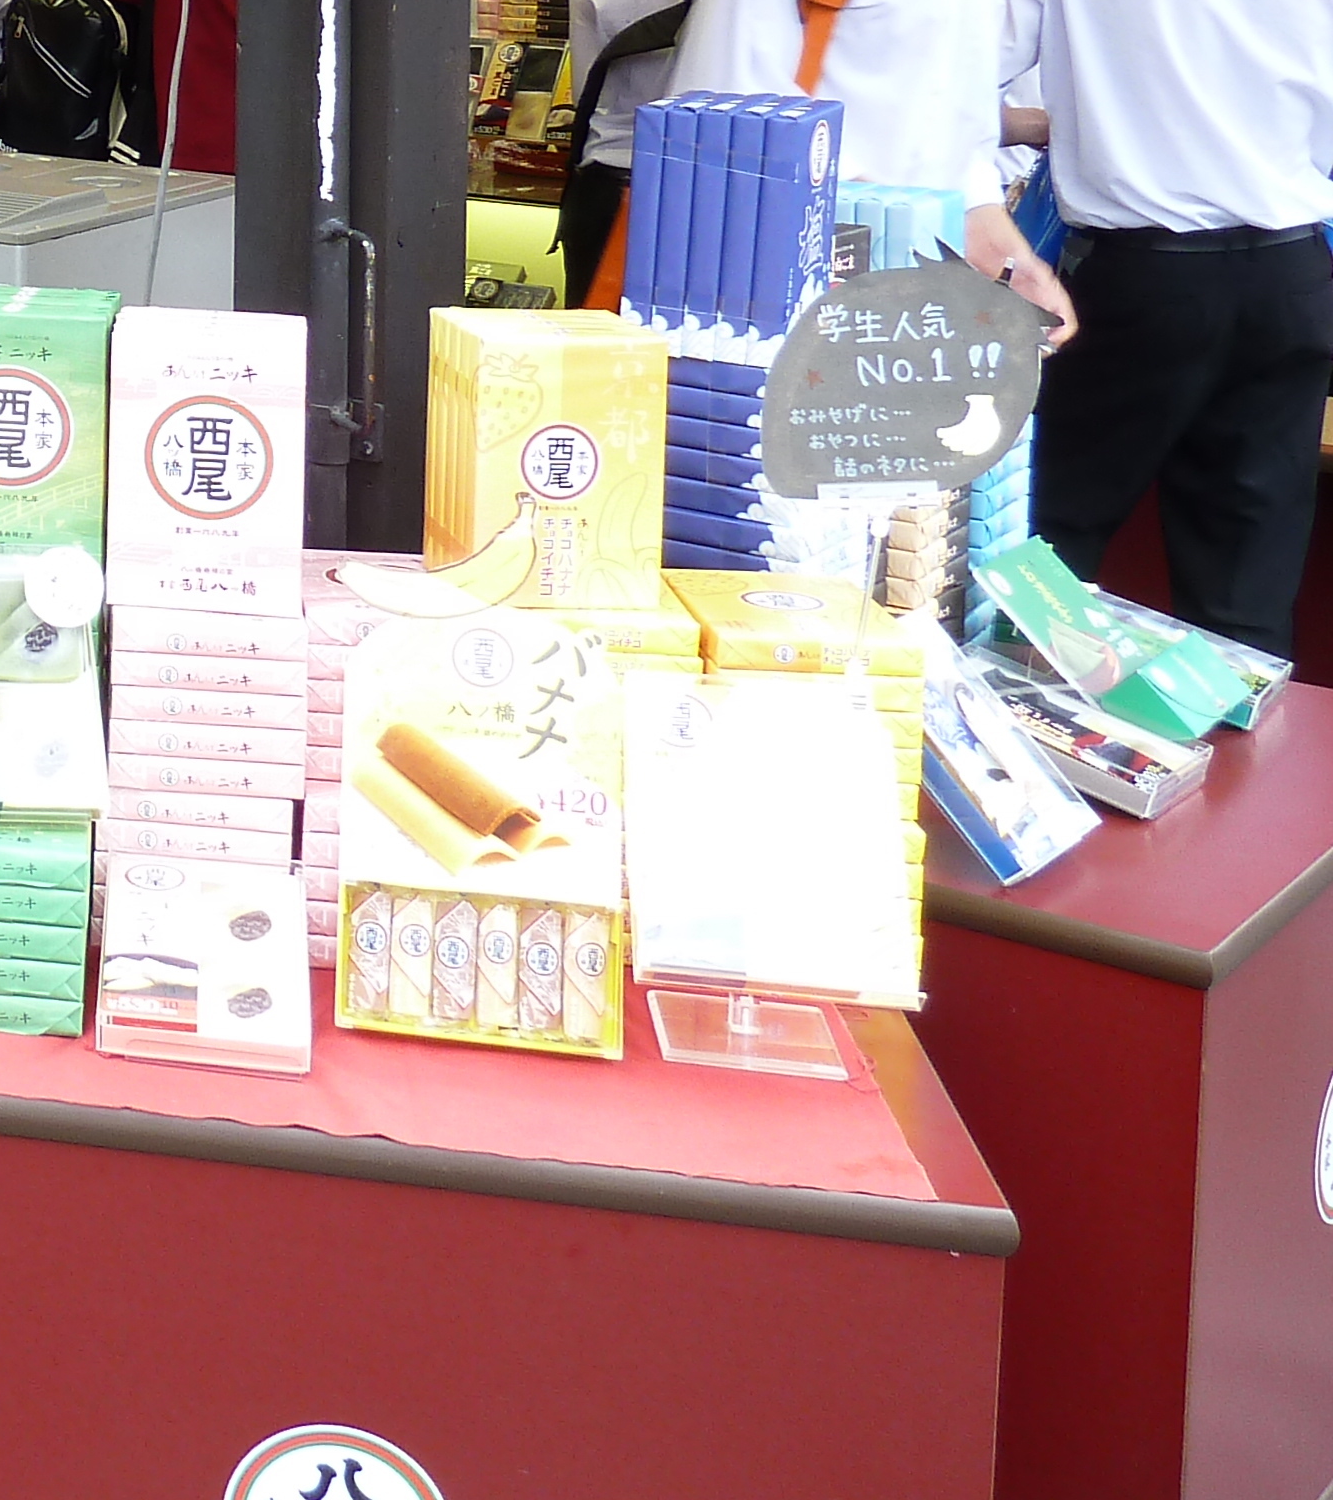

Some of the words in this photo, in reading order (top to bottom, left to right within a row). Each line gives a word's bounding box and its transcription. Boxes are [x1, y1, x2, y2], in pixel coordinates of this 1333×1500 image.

[817, 302, 955, 343] 学生人気
[10, 347, 52, 361] ニッキ
[209, 365, 258, 383] ニッキ
[35, 409, 55, 449] 本家
[182, 416, 233, 501] 西尾
[236, 438, 257, 480] 本家
[543, 437, 575, 488] 西尾
[473, 637, 495, 679] 西尾
[537, 789, 607, 815] ¥420
[2, 862, 37, 875] ニッキ
[2, 896, 36, 910] ニッキ
